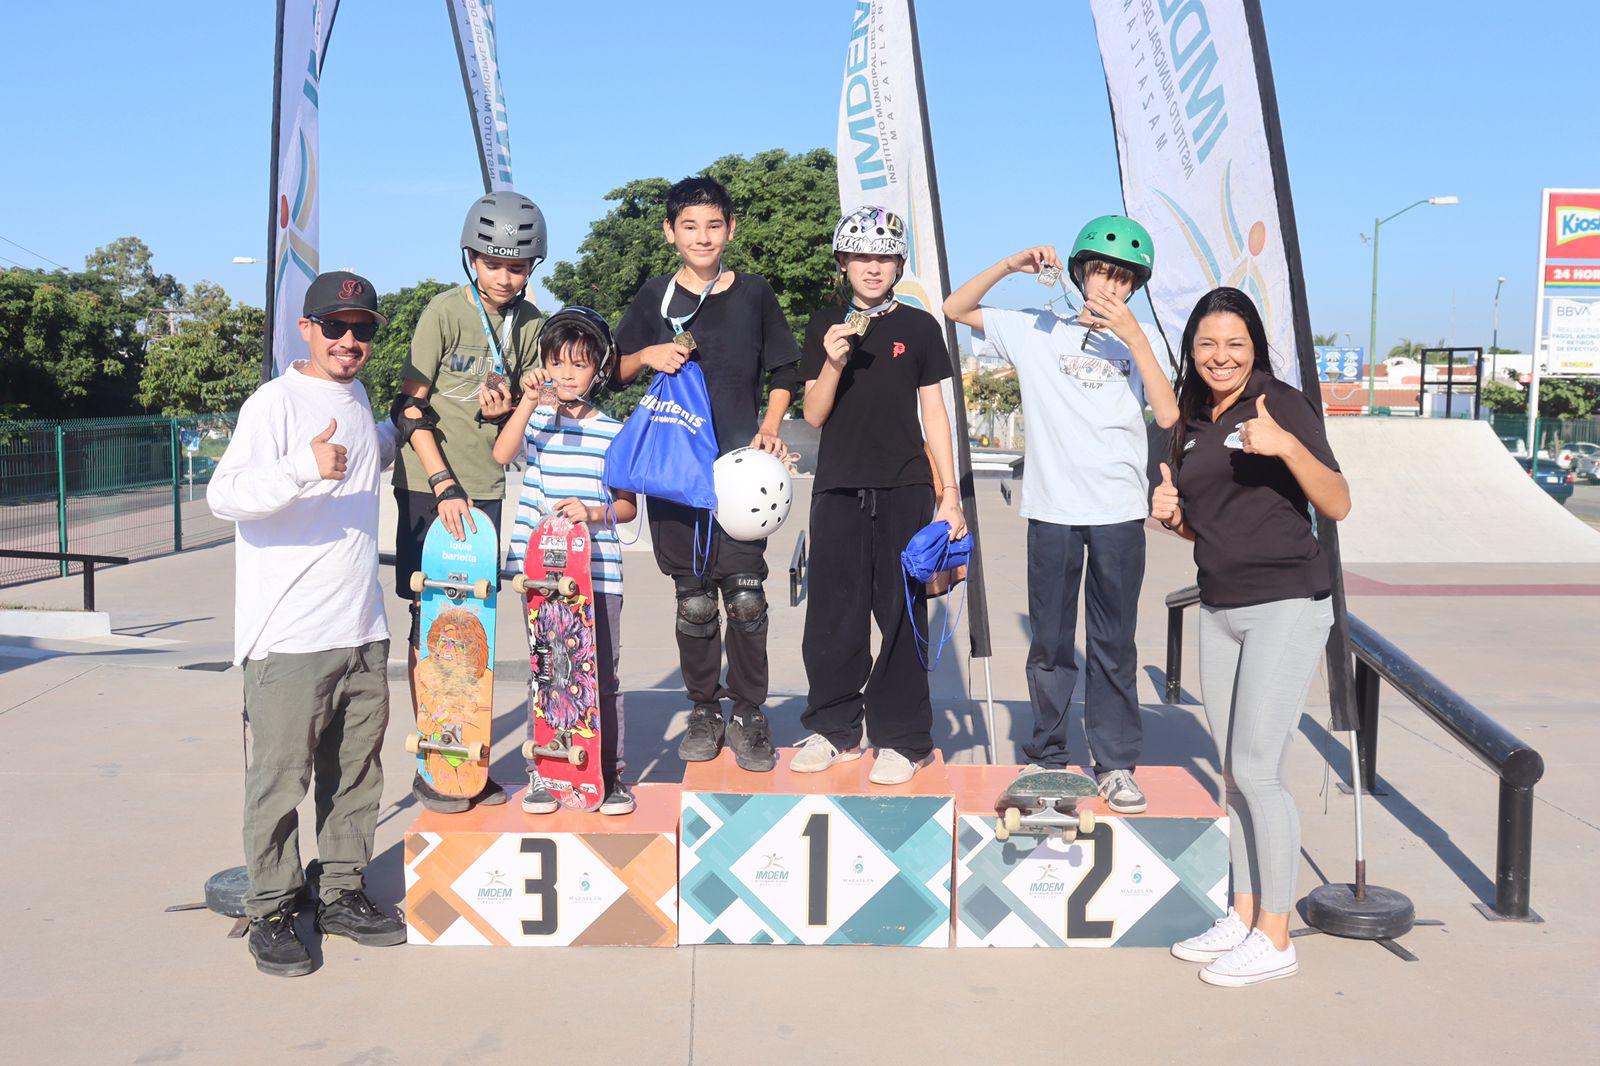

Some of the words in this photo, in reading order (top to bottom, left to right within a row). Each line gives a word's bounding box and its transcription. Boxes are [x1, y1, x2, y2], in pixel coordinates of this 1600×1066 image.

[871, 52, 884, 118] MUNICIPAL
[879, 121, 897, 184] INSTITUTO
[1562, 213, 1600, 236] Kios
[1553, 269, 1571, 281] 24
[1557, 306, 1591, 317] BBVA
[755, 870, 789, 880] IMDEM
[802, 813, 829, 926] 1
[1066, 822, 1115, 939] 2
[477, 888, 513, 898] IMDEM
[520, 838, 558, 935] 3
[1029, 882, 1065, 892] IMDEM
